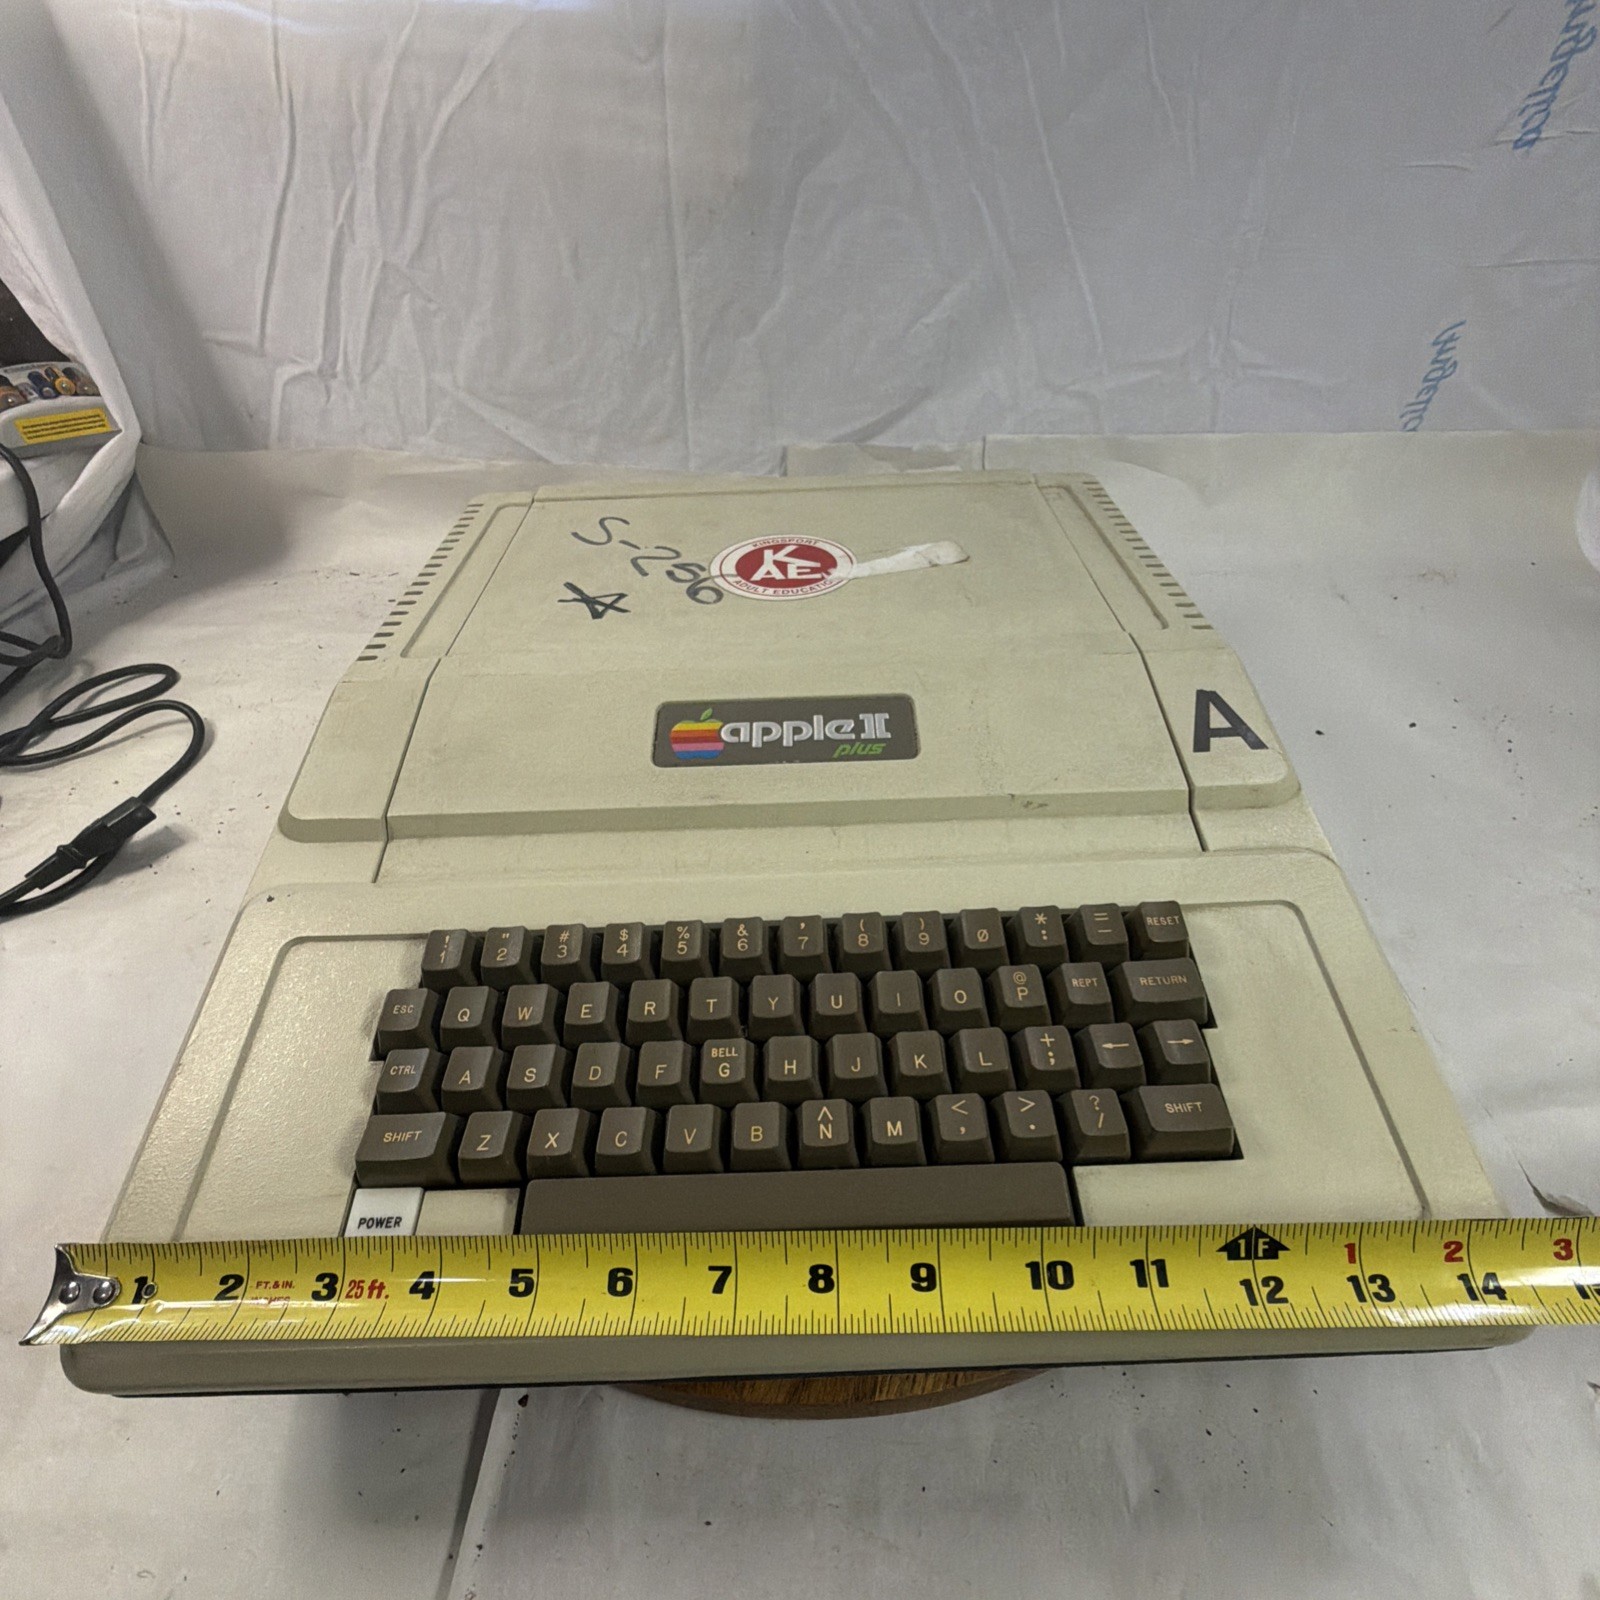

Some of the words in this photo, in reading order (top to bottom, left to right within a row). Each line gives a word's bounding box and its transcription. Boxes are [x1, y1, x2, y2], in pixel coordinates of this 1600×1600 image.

[752, 538, 819, 548] KINGSPORT
[733, 580, 768, 594] ADULT
[772, 580, 835, 595] EDUCATIO
[1193, 689, 1269, 753] A
[720, 714, 855, 748] apple
[833, 743, 887, 759] plus
[1146, 915, 1180, 927] RESET
[560, 930, 570, 942] #
[619, 929, 628, 941] $
[677, 926, 689, 939] %
[737, 924, 748, 937] &
[737, 938, 748, 951] 6
[798, 937, 809, 950] 7
[858, 934, 869, 947] 8
[918, 932, 930, 945] 9
[496, 947, 508, 961] 2
[557, 945, 567, 958] 3
[617, 944, 628, 957] 4
[677, 942, 688, 955] 5
[438, 951, 447, 963] 1
[1013, 971, 1027, 984] @
[1071, 976, 1098, 988] REPT
[1140, 974, 1187, 987] RETURN
[954, 990, 967, 1004] O
[1017, 987, 1029, 1001] P
[392, 1003, 414, 1015] ESC
[644, 1001, 656, 1015] R
[705, 999, 718, 1013] T
[768, 997, 779, 1010] Y
[830, 995, 843, 1009] U
[457, 1008, 471, 1022] Q
[518, 1006, 533, 1020] W
[581, 1004, 593, 1018] E
[1040, 1033, 1055, 1048] +
[711, 1047, 738, 1058] BELL
[979, 1051, 992, 1066] L
[784, 1060, 797, 1075] H
[851, 1057, 861, 1072] J
[914, 1054, 927, 1069] K
[389, 1064, 417, 1076] CTRL
[459, 1070, 473, 1084] A
[524, 1068, 537, 1082] S
[589, 1066, 602, 1081] D
[655, 1064, 668, 1079] F
[718, 1063, 731, 1077] G
[951, 1099, 967, 1116] <
[1020, 1097, 1036, 1113] >
[1089, 1094, 1100, 1110] ?
[1164, 1101, 1203, 1114] SHIFT
[383, 1129, 422, 1143] SHIFT
[751, 1126, 763, 1142] B
[819, 1123, 833, 1139] N
[887, 1120, 902, 1137] M
[476, 1135, 490, 1151] Z
[545, 1132, 560, 1148] X
[615, 1131, 628, 1147] C
[684, 1128, 697, 1145] V
[357, 1216, 403, 1230] POWER
[1343, 1243, 1357, 1264] 1
[1443, 1240, 1465, 1263] 2
[1553, 1238, 1574, 1261] 3
[707, 1265, 733, 1295] 7
[808, 1263, 836, 1294] 8
[910, 1262, 938, 1292] 9
[1025, 1259, 1075, 1291] 10
[1129, 1259, 1170, 1289] 11
[214, 1273, 245, 1302] 2
[311, 1272, 339, 1301] 3
[345, 1279, 366, 1300] 25
[367, 1279, 390, 1300] ft.
[409, 1270, 436, 1300] 4
[508, 1268, 536, 1298] 5
[606, 1267, 634, 1297] 6
[1346, 1273, 1397, 1303] 13
[1457, 1271, 1507, 1302] 14
[131, 1276, 148, 1304] 1
[1239, 1275, 1289, 1306] 12
